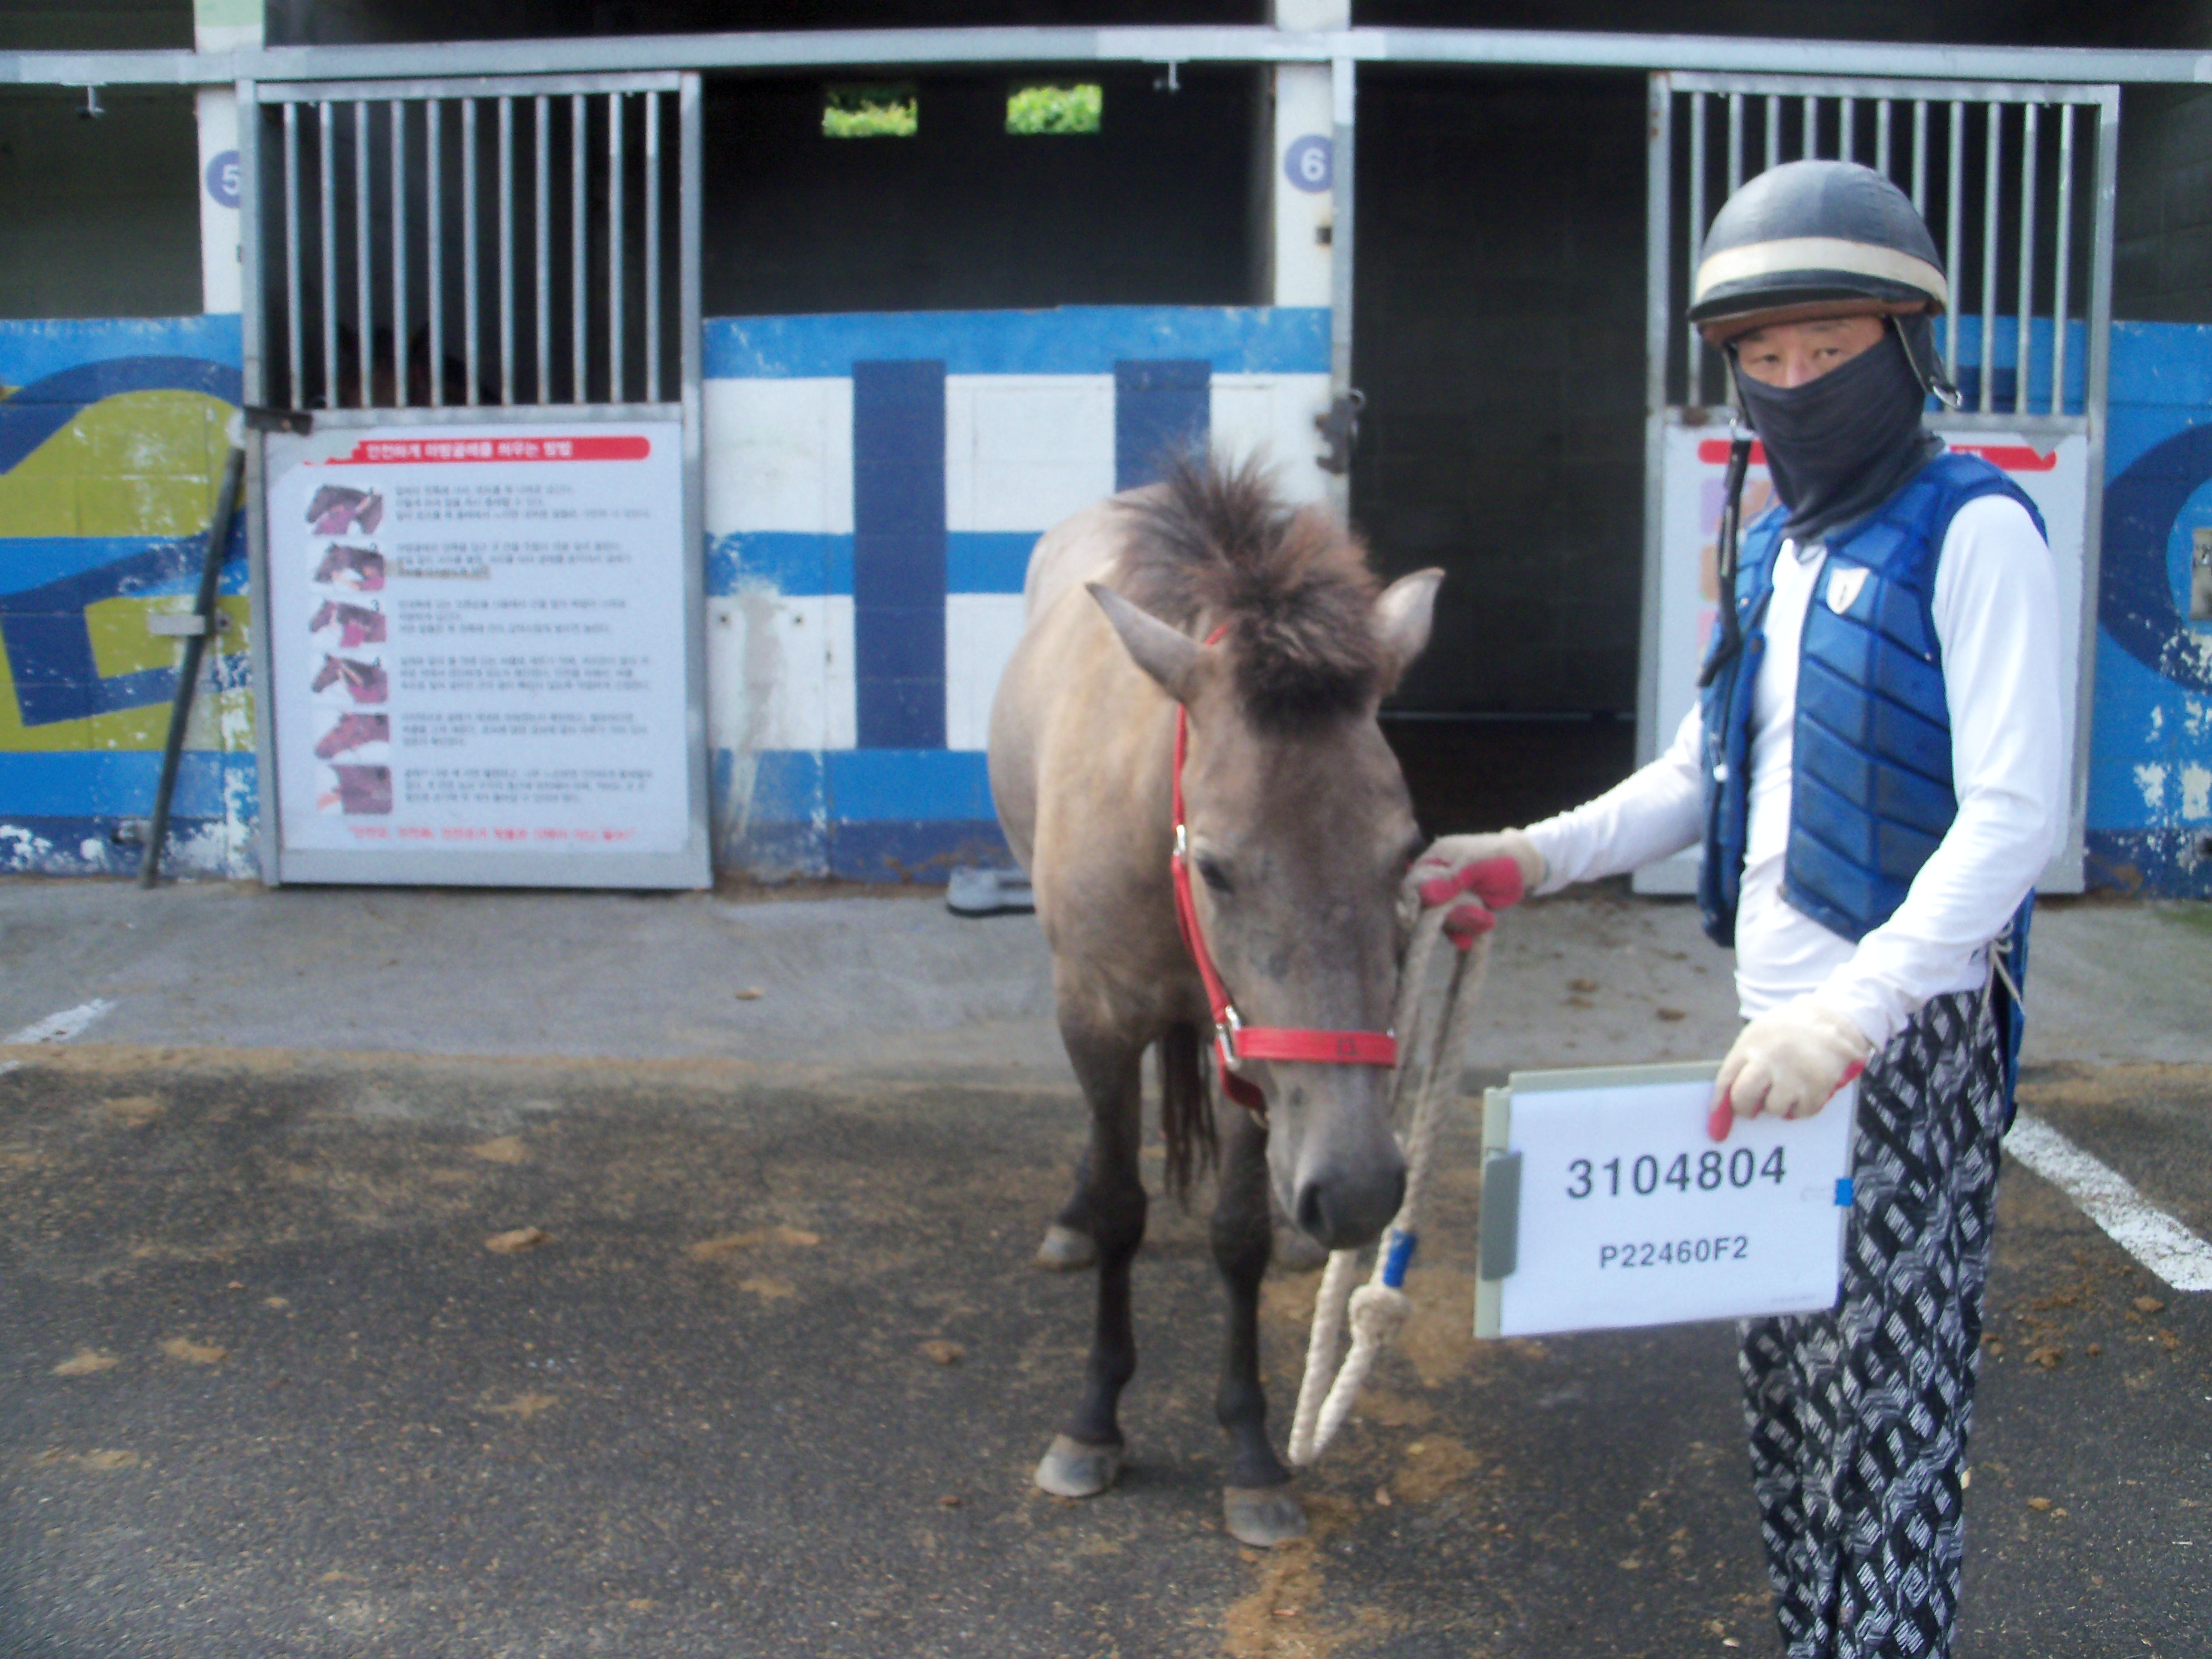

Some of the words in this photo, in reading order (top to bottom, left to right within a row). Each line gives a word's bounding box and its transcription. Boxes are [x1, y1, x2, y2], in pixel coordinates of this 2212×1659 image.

[222, 164, 240, 195] 5
[1301, 147, 1326, 182] 6
[1565, 1146, 1787, 1200] 3104804
[1599, 1235, 1749, 1269] P22460F2
